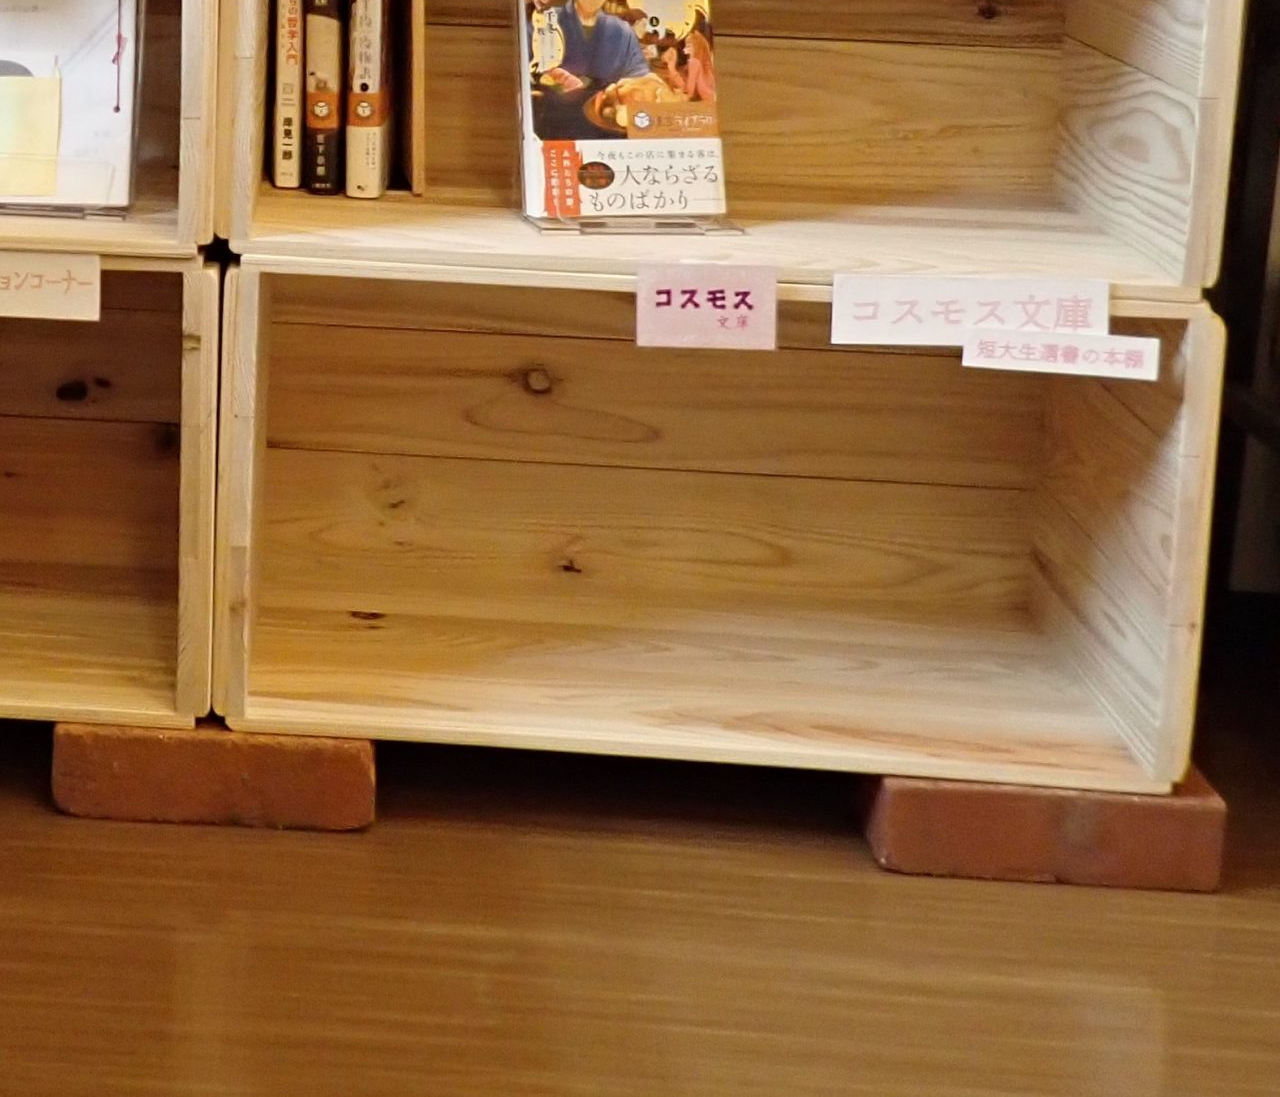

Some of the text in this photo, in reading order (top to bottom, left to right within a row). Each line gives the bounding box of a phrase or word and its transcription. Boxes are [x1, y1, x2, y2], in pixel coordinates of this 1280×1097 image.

[620, 164, 719, 186] 人ならざる
[654, 286, 755, 312] コスモス
[717, 314, 750, 331] 文庫
[851, 293, 1094, 333] コスモス文庫
